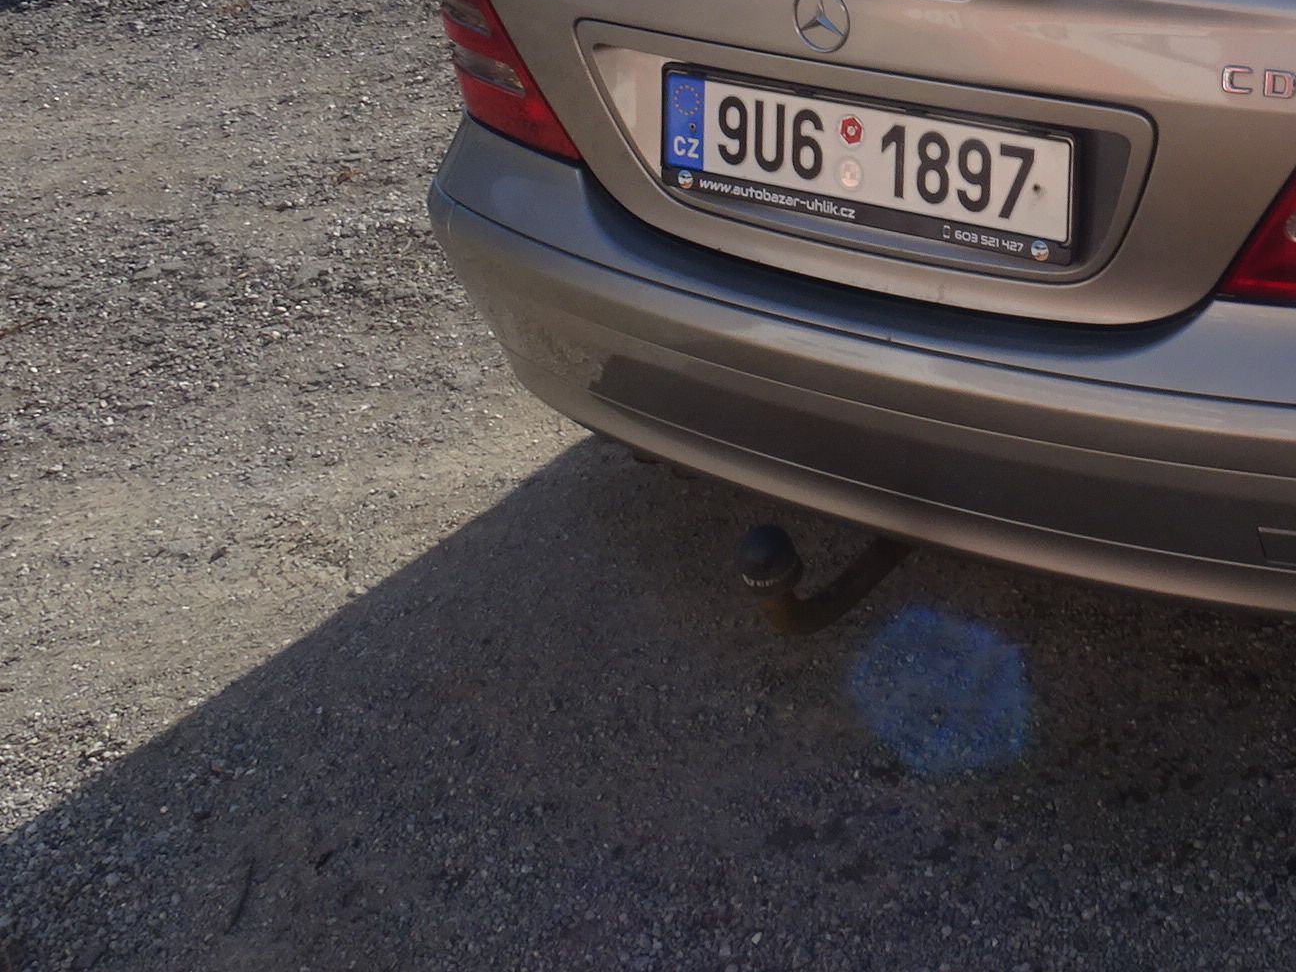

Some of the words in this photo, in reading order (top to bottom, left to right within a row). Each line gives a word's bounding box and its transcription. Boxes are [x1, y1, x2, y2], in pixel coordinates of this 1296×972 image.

[673, 135, 700, 159] CZ
[718, 95, 825, 180] 9U6
[881, 124, 1036, 220] 1897
[699, 178, 856, 219] www.autobazar-uhlik.cz
[954, 230, 979, 244] 603
[981, 234, 1000, 248] 521
[1001, 238, 1024, 253] 427
